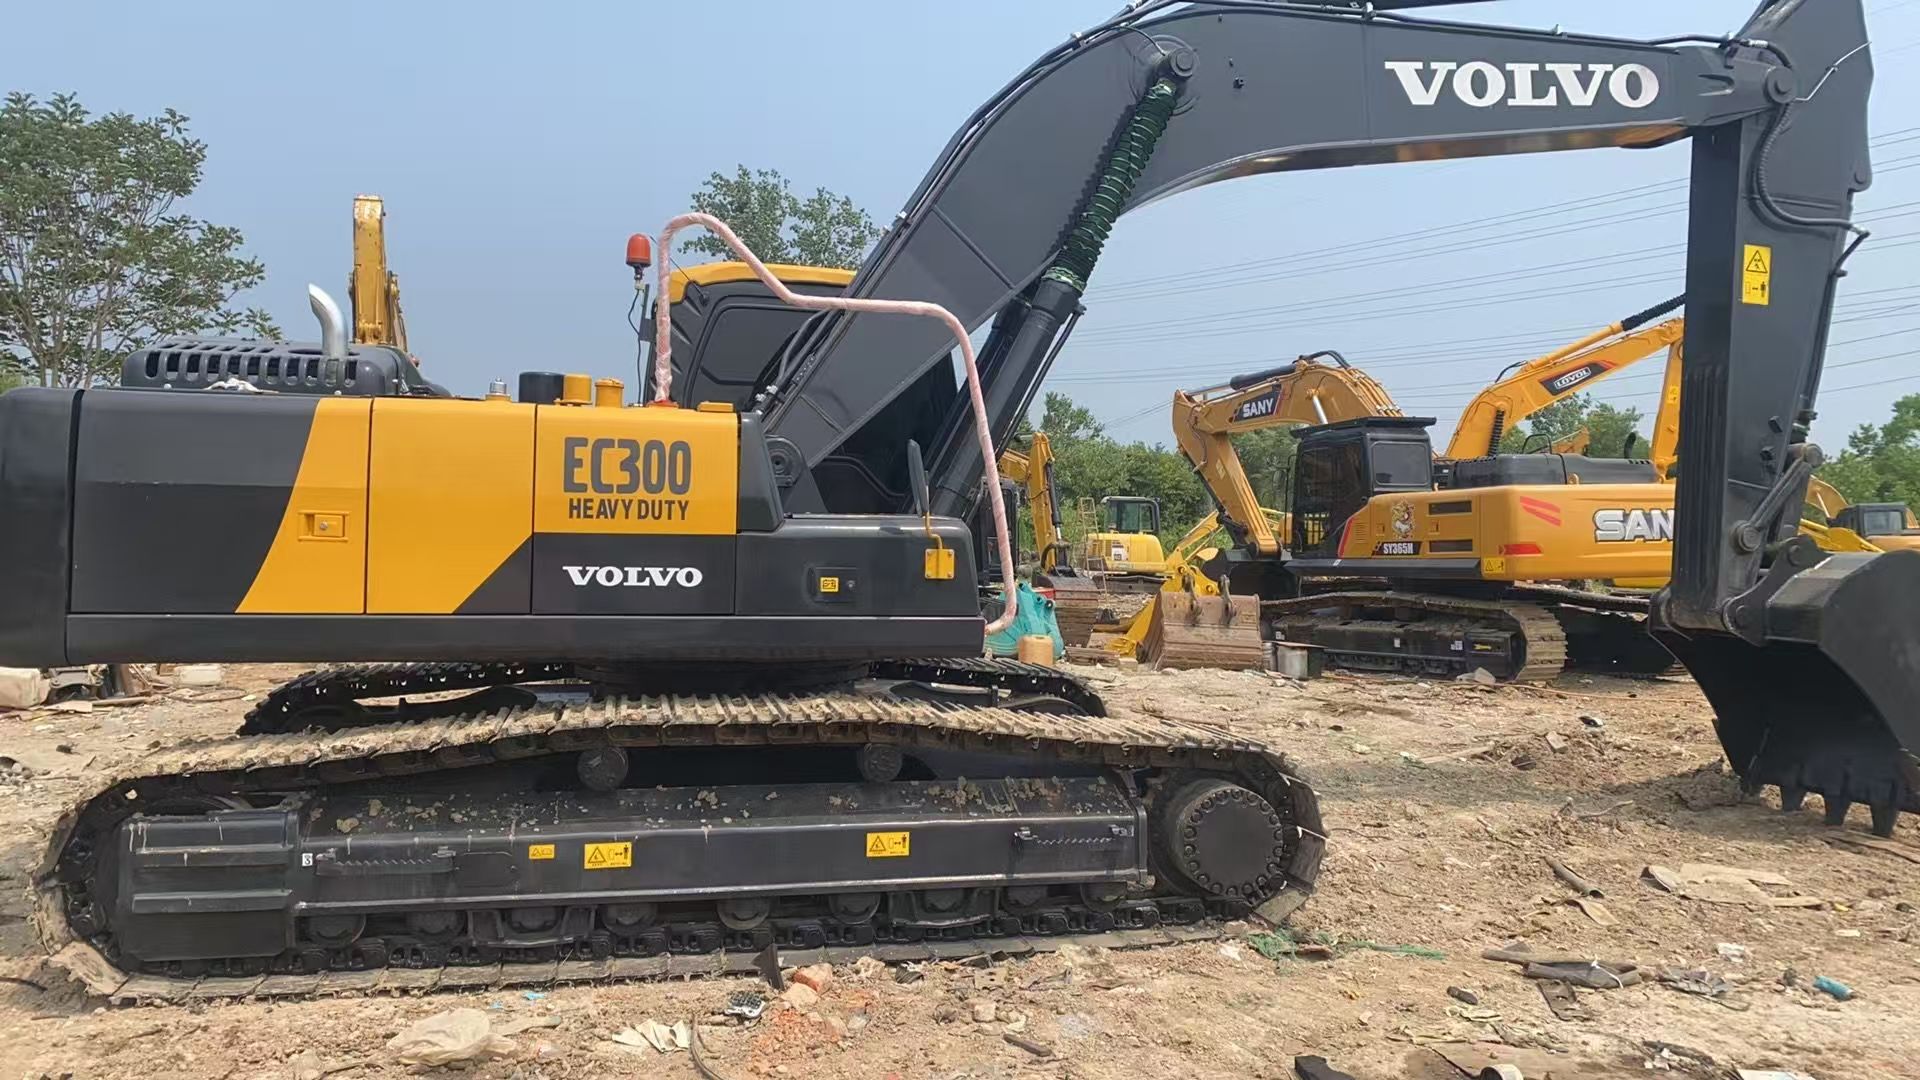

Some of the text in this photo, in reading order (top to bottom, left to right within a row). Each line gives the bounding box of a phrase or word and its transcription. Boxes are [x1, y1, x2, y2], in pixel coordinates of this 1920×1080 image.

[1384, 61, 1660, 108] VOLVO
[1555, 368, 1589, 387] LOVOL
[1242, 397, 1274, 418] SANY
[563, 437, 692, 495] EC300
[568, 498, 689, 521] HEAVY DUTY
[562, 565, 703, 588] VOLVO
